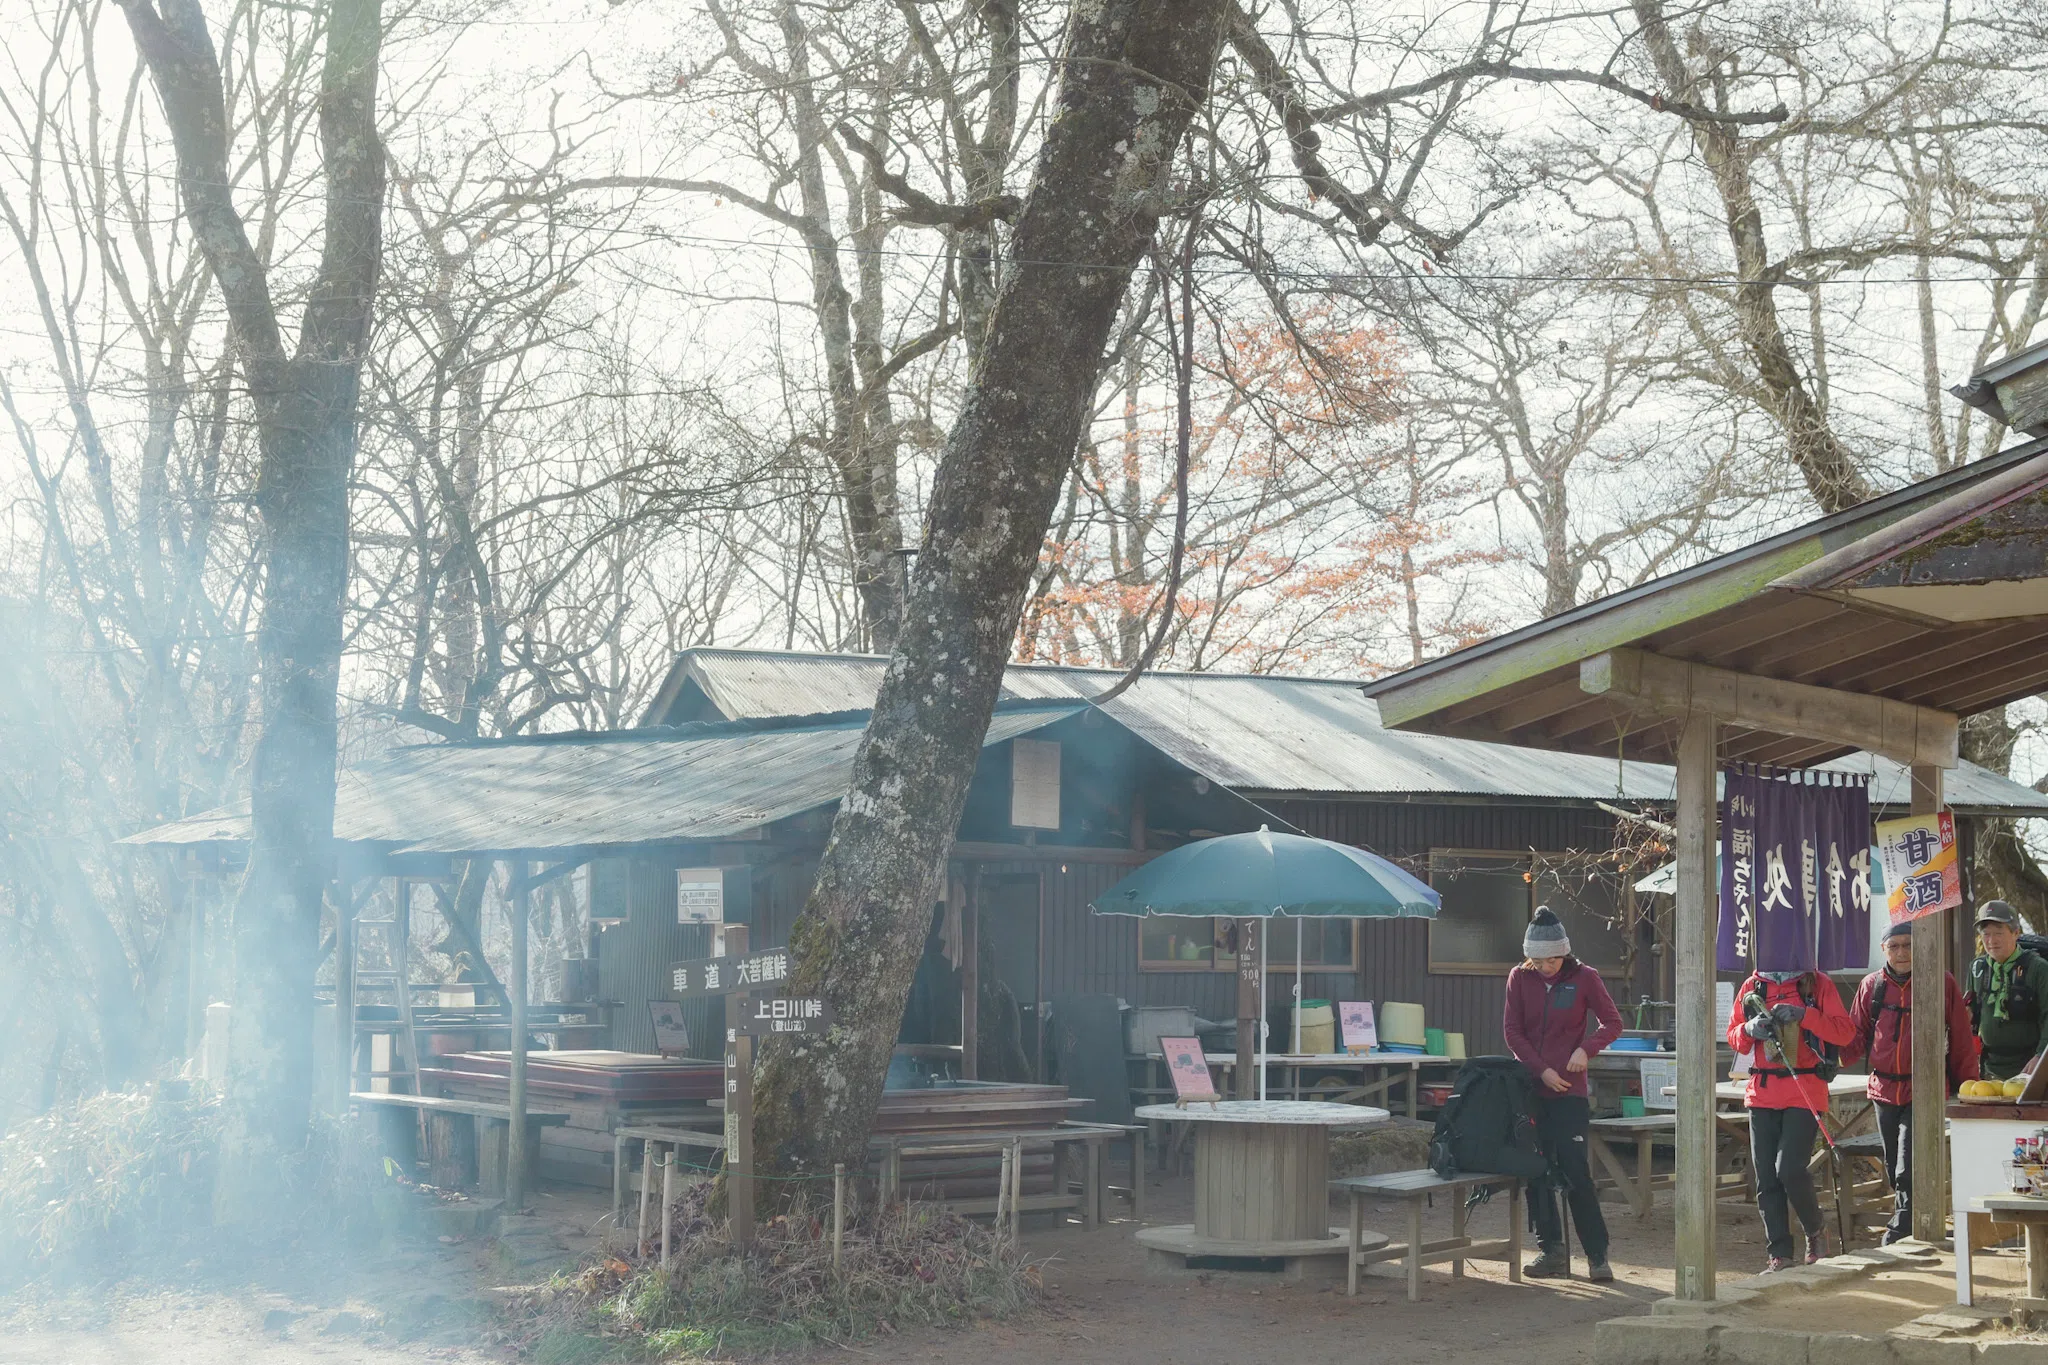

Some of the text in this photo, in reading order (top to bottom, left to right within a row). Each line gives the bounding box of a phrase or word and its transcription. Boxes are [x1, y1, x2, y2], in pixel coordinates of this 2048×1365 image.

[1941, 820, 1953, 844] 本格
[1895, 828, 1943, 914] 甘酒
[672, 963, 720, 993] 車道
[736, 954, 787, 985] 大菩薩峠
[753, 999, 822, 1019] 上日川峠
[727, 1028, 737, 1092] 塩山市
